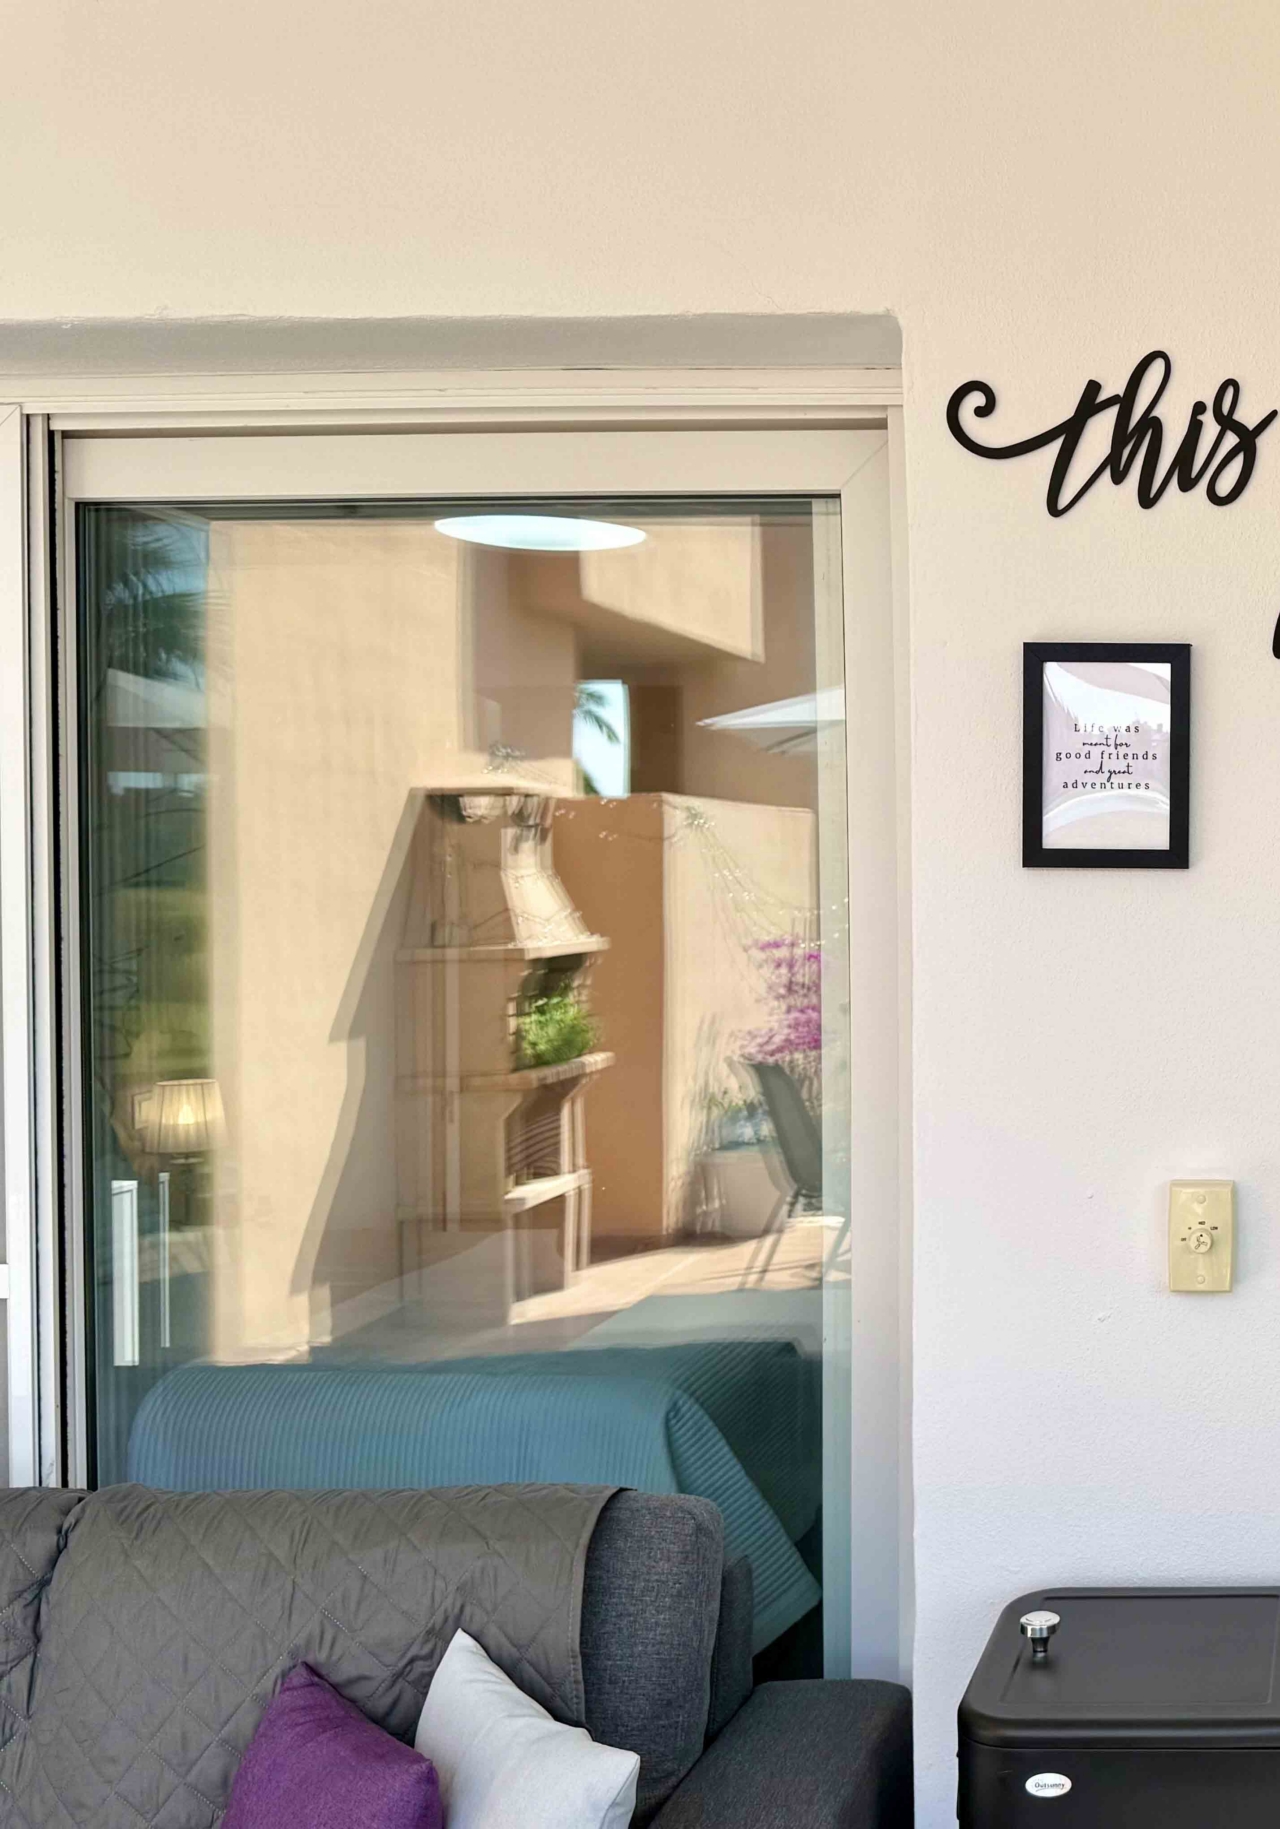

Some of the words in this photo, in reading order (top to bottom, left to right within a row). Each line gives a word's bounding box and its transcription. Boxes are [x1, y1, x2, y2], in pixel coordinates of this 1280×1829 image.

[946, 350, 1278, 518] this
[1074, 723, 1105, 733] Life
[1113, 724, 1140, 733] was
[1082, 734, 1112, 748] meant
[1114, 734, 1131, 750] for
[1055, 750, 1092, 762] good
[1100, 750, 1158, 761] friends
[1084, 760, 1105, 775] and
[1107, 762, 1133, 783] great
[1062, 780, 1150, 790] adventures
